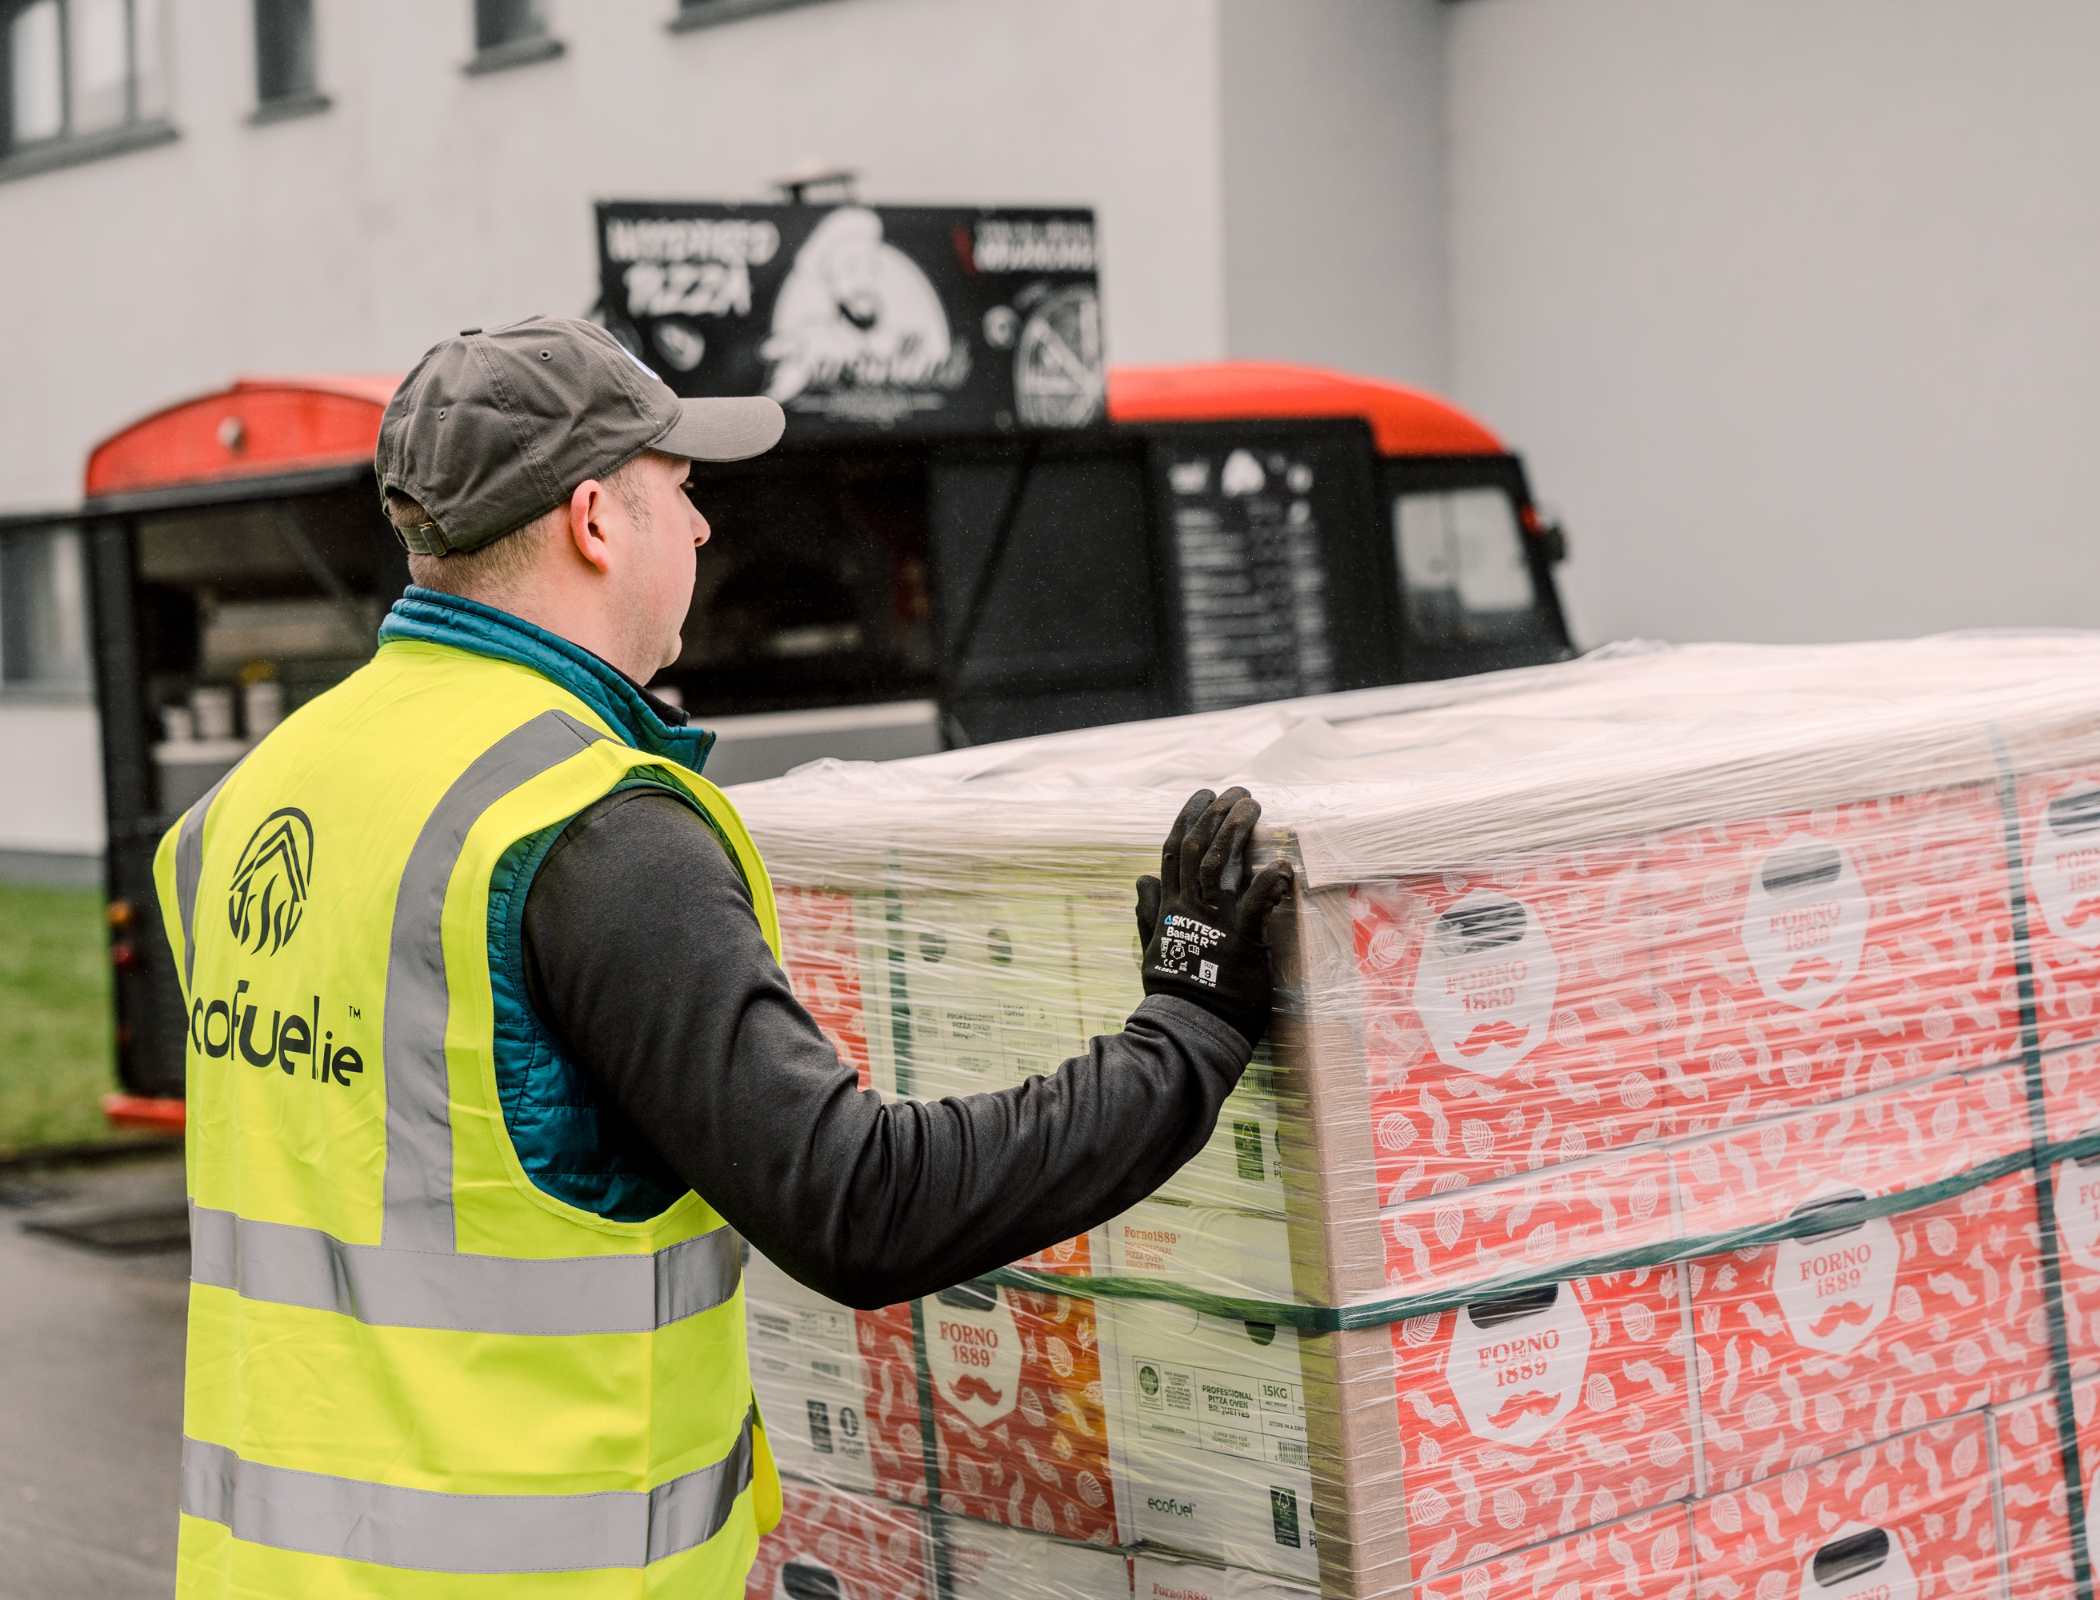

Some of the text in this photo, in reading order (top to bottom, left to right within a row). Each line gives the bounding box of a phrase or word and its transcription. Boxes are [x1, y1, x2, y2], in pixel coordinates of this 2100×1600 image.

[1166, 926, 1200, 944] Basalt
[1204, 969, 1212, 979] 9
[187, 979, 363, 1086] cofuel.ie
[1800, 1243, 1872, 1281] FORNO
[1816, 1267, 1861, 1299] 1889
[939, 1320, 999, 1349] FORNO
[1477, 1328, 1560, 1369] FORNO
[952, 1344, 990, 1368] 1889
[1495, 1355, 1547, 1388] 1889
[1208, 1394, 1249, 1410] PIZZA OVEN
[1261, 1384, 1288, 1400] 15KG
